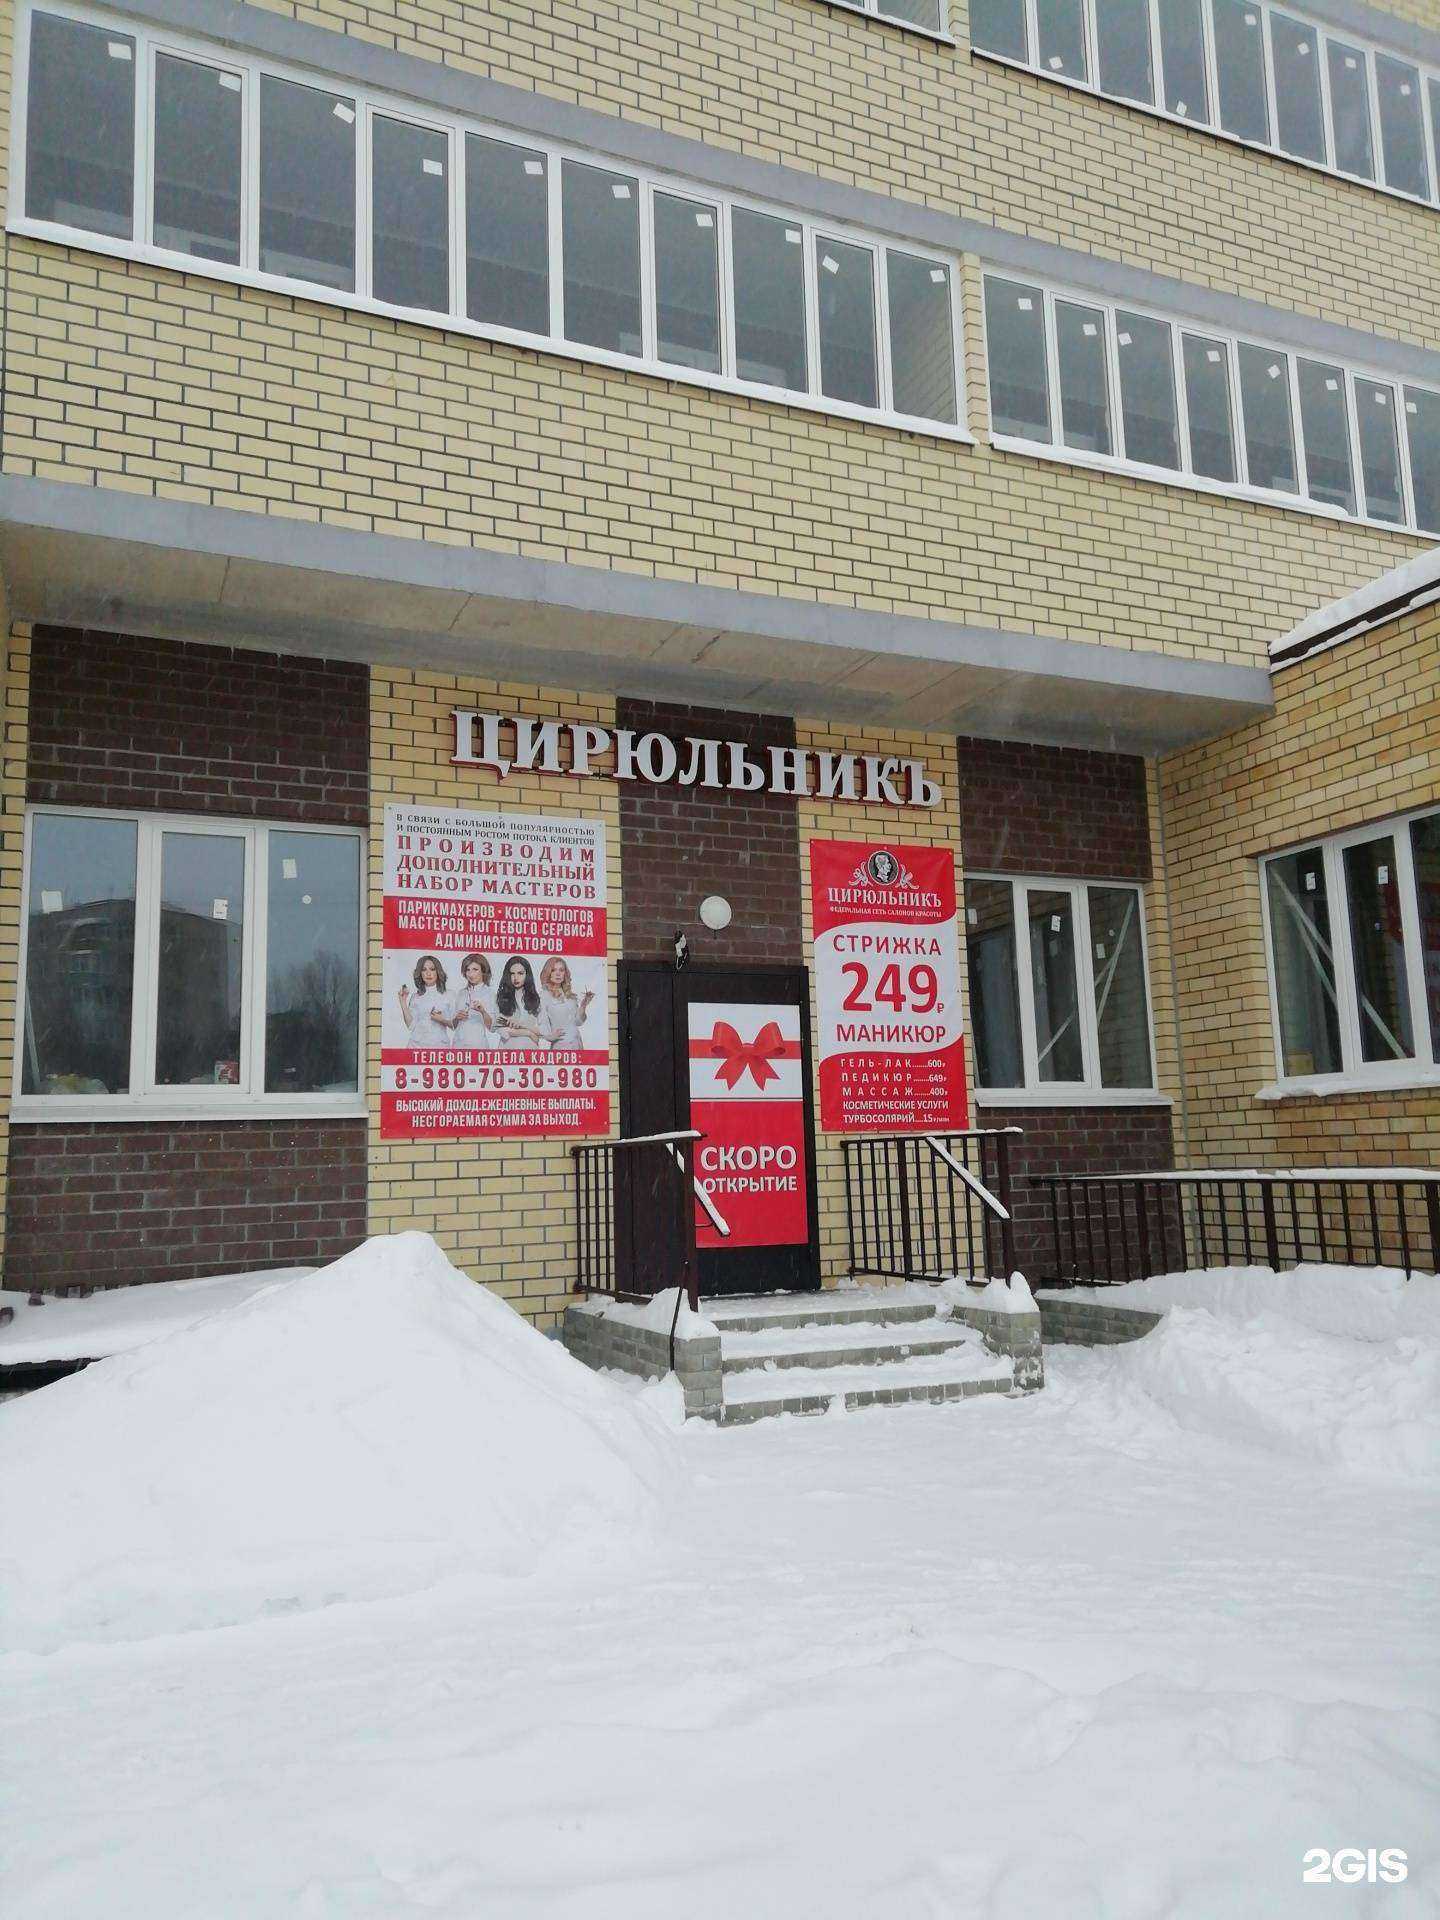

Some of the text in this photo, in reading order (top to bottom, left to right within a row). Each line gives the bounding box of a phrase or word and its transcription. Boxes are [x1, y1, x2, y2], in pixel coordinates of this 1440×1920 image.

[450, 709, 943, 808] ЦИРЮЛЬНИКЪ
[396, 814, 595, 836] В СВЯЗИ С БОЛЬШОЙ ПОПУЛЯРНОСТЬЮ
[396, 824, 595, 846] И ПОСТОЯННЫМ РОСТОМ ПОТОКА КЛИЕНТОВ
[397, 835, 595, 863] ПРОИЗВОДИМ
[396, 855, 596, 881] ДОПОЛНИТЕЛЬНЫЙ
[397, 874, 596, 899] НАБОР МАСТЕРОВ
[828, 887, 942, 908] ЦИРЮЛЬНИКЪ
[398, 900, 594, 924] ПАРИКМАХЕРОВ КОСМЕТОЛОГОВ
[398, 915, 594, 938] МАСТЕРОВ НОГТЕВОГО СЕРВИСА
[435, 933, 563, 952] АДМИНИСТРАТОРОВ
[833, 934, 942, 956] СТРИЖКА
[836, 1024, 946, 1043] МАНИКЮР
[413, 1051, 582, 1065] ТЕЛЕФОН ОТДЕЛА КАДРОВ:
[395, 1067, 597, 1089] 8-980-70-30-980
[396, 1097, 443, 1112] ВЫСОКИЙ
[548, 1098, 597, 1110] ВЫПЛАТЫ.
[843, 1100, 949, 1110] КОСМЕТИЧЕСКИЕ УСЛУГИ
[412, 1113, 582, 1128] НЕСГОРАЕМАЯ СУММА ЗА ВЫХОД.
[700, 1145, 797, 1171] СКОРО
[702, 1176, 798, 1194] ОТКРЫТИЕ
